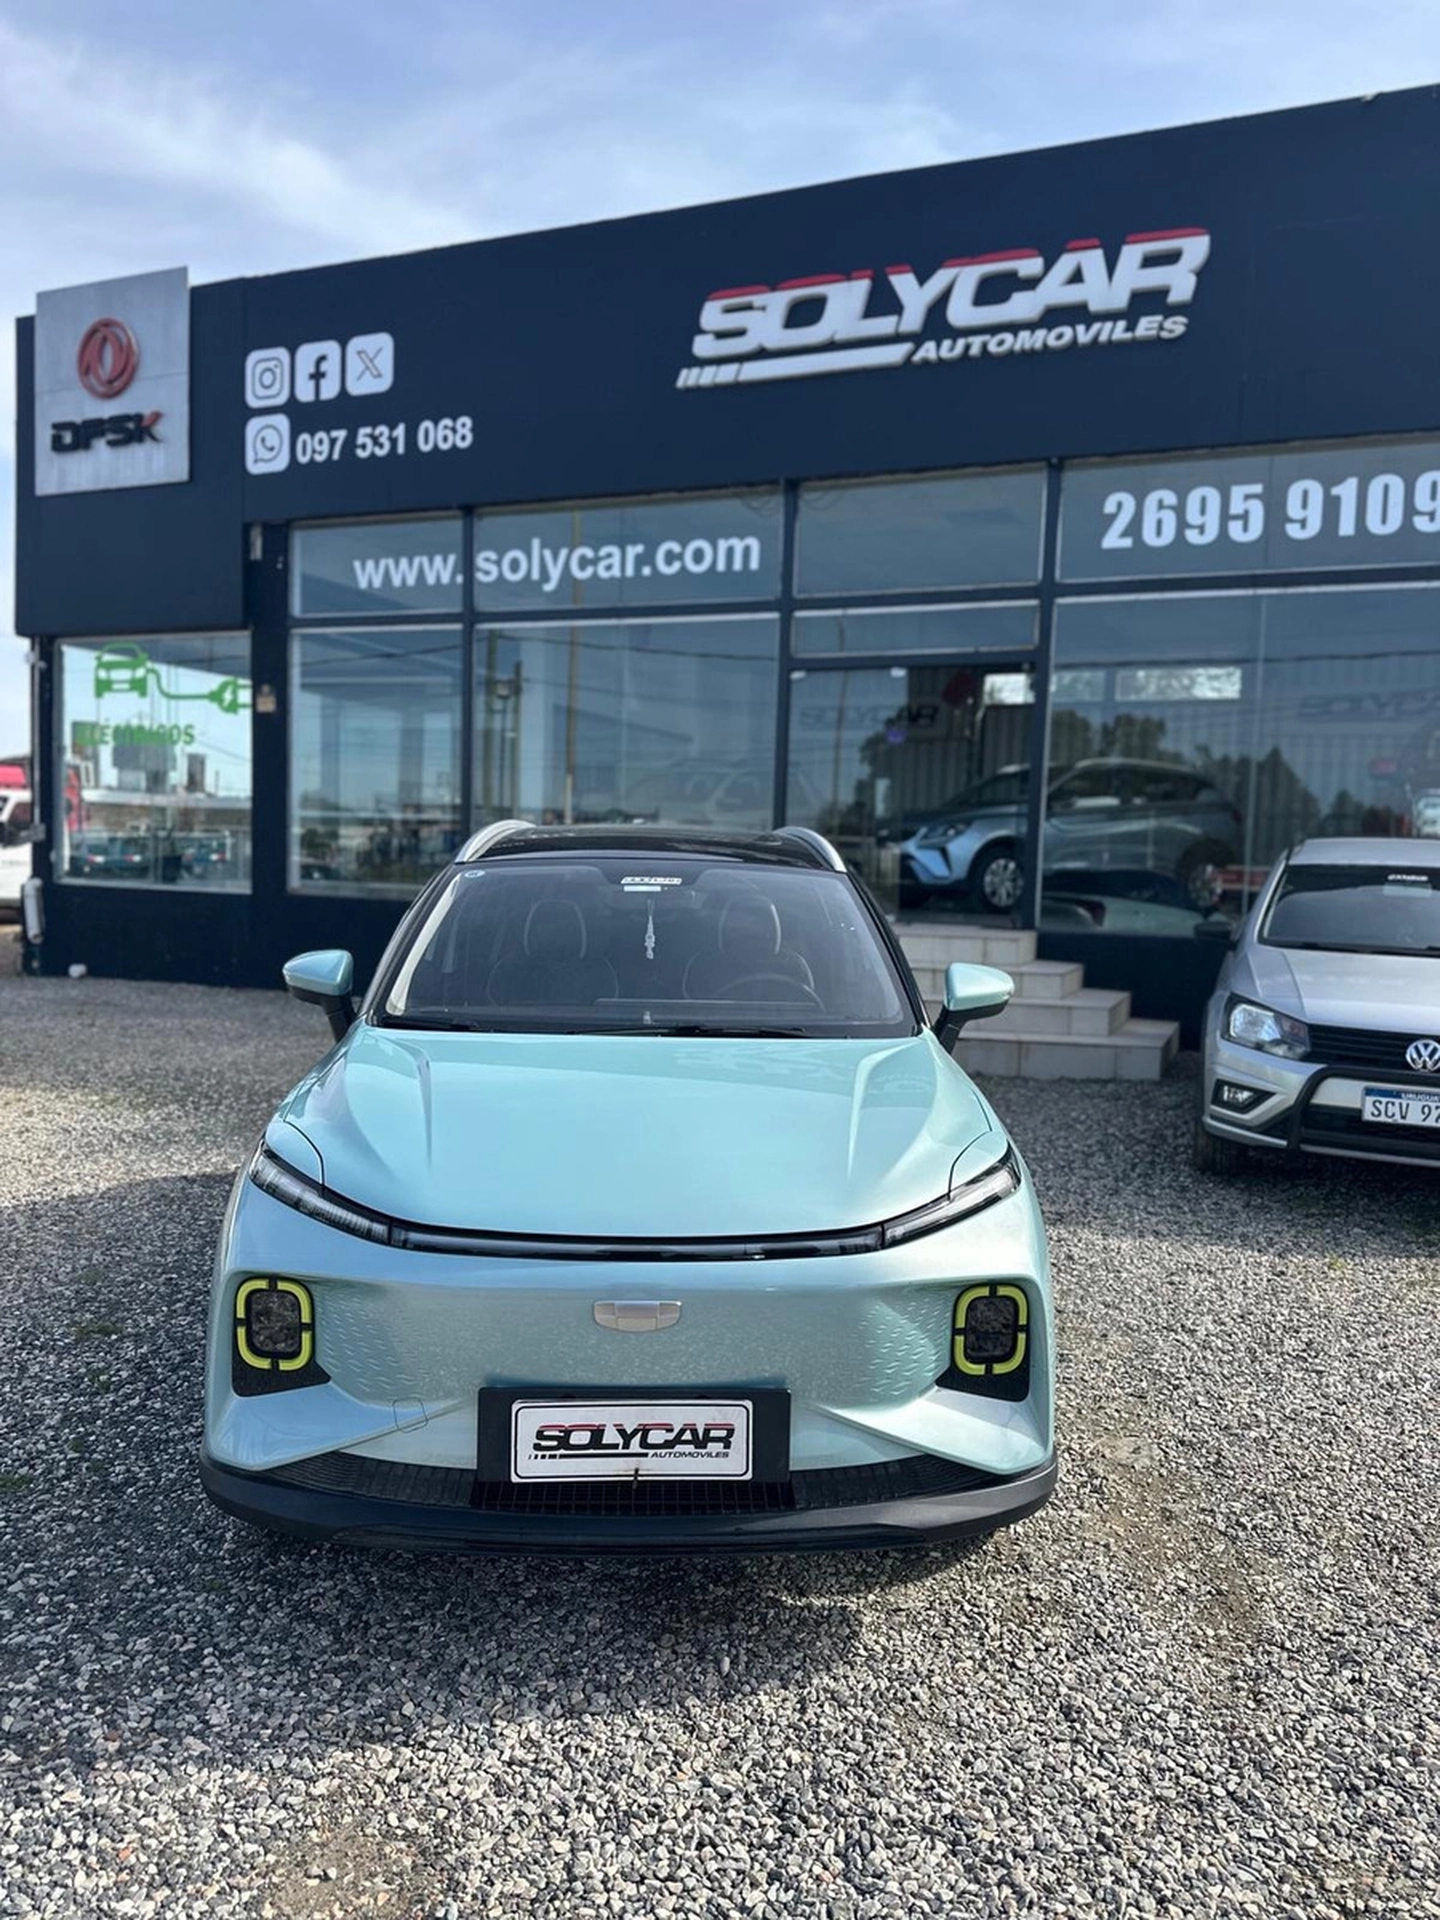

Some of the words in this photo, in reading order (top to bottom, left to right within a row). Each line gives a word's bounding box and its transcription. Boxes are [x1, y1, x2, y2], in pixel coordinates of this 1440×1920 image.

[692, 227, 1211, 359] SOLYCAR
[911, 316, 1188, 363] AUTOMOVILES
[296, 430, 348, 464] 097
[356, 422, 406, 459] 531
[417, 415, 473, 453] 068
[1101, 483, 1265, 549] 2695
[1284, 470, 1440, 540] 9109
[1371, 1099, 1410, 1120] SCV
[533, 1423, 735, 1452] SOLYCAR
[651, 1451, 729, 1459] AUTOMOVILES
